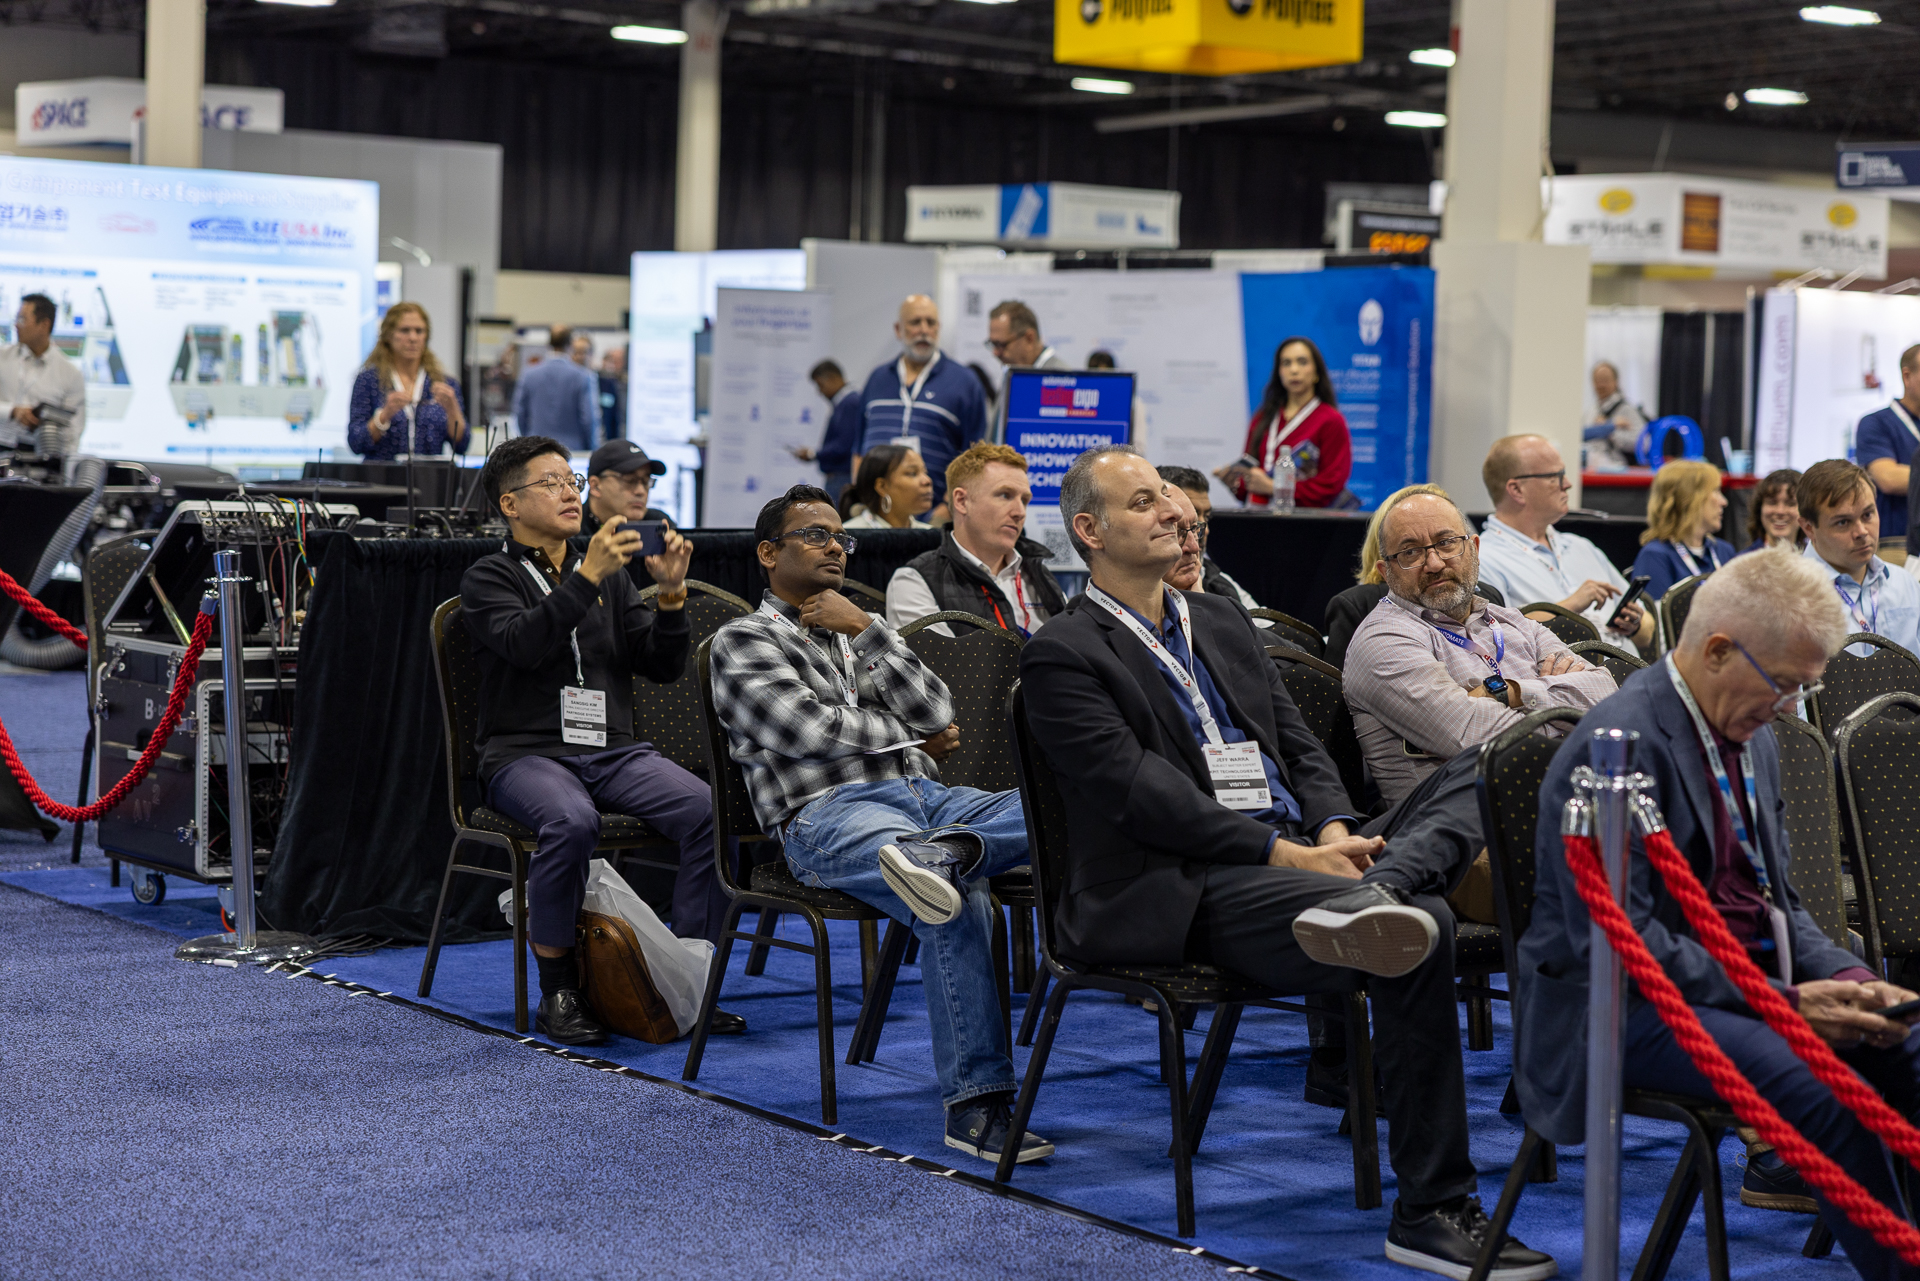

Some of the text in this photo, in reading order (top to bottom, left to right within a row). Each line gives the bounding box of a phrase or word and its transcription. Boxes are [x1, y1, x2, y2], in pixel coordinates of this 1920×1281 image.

[6, 169, 125, 199] Component
[130, 177, 171, 201] Test
[1073, 388, 1100, 411] expo
[1020, 432, 1112, 449] INNOVATION
[1024, 452, 1077, 468] SHOWC
[1027, 472, 1063, 487] SCHE
[537, 575, 549, 591] VECTOR
[1100, 597, 1118, 612] VECTOR
[778, 617, 793, 629] VECTOR
[1136, 625, 1154, 644] VECTOR
[809, 642, 825, 657] VECTOR
[1171, 661, 1187, 682] VECTOR
[1484, 654, 1501, 675] dSPA
